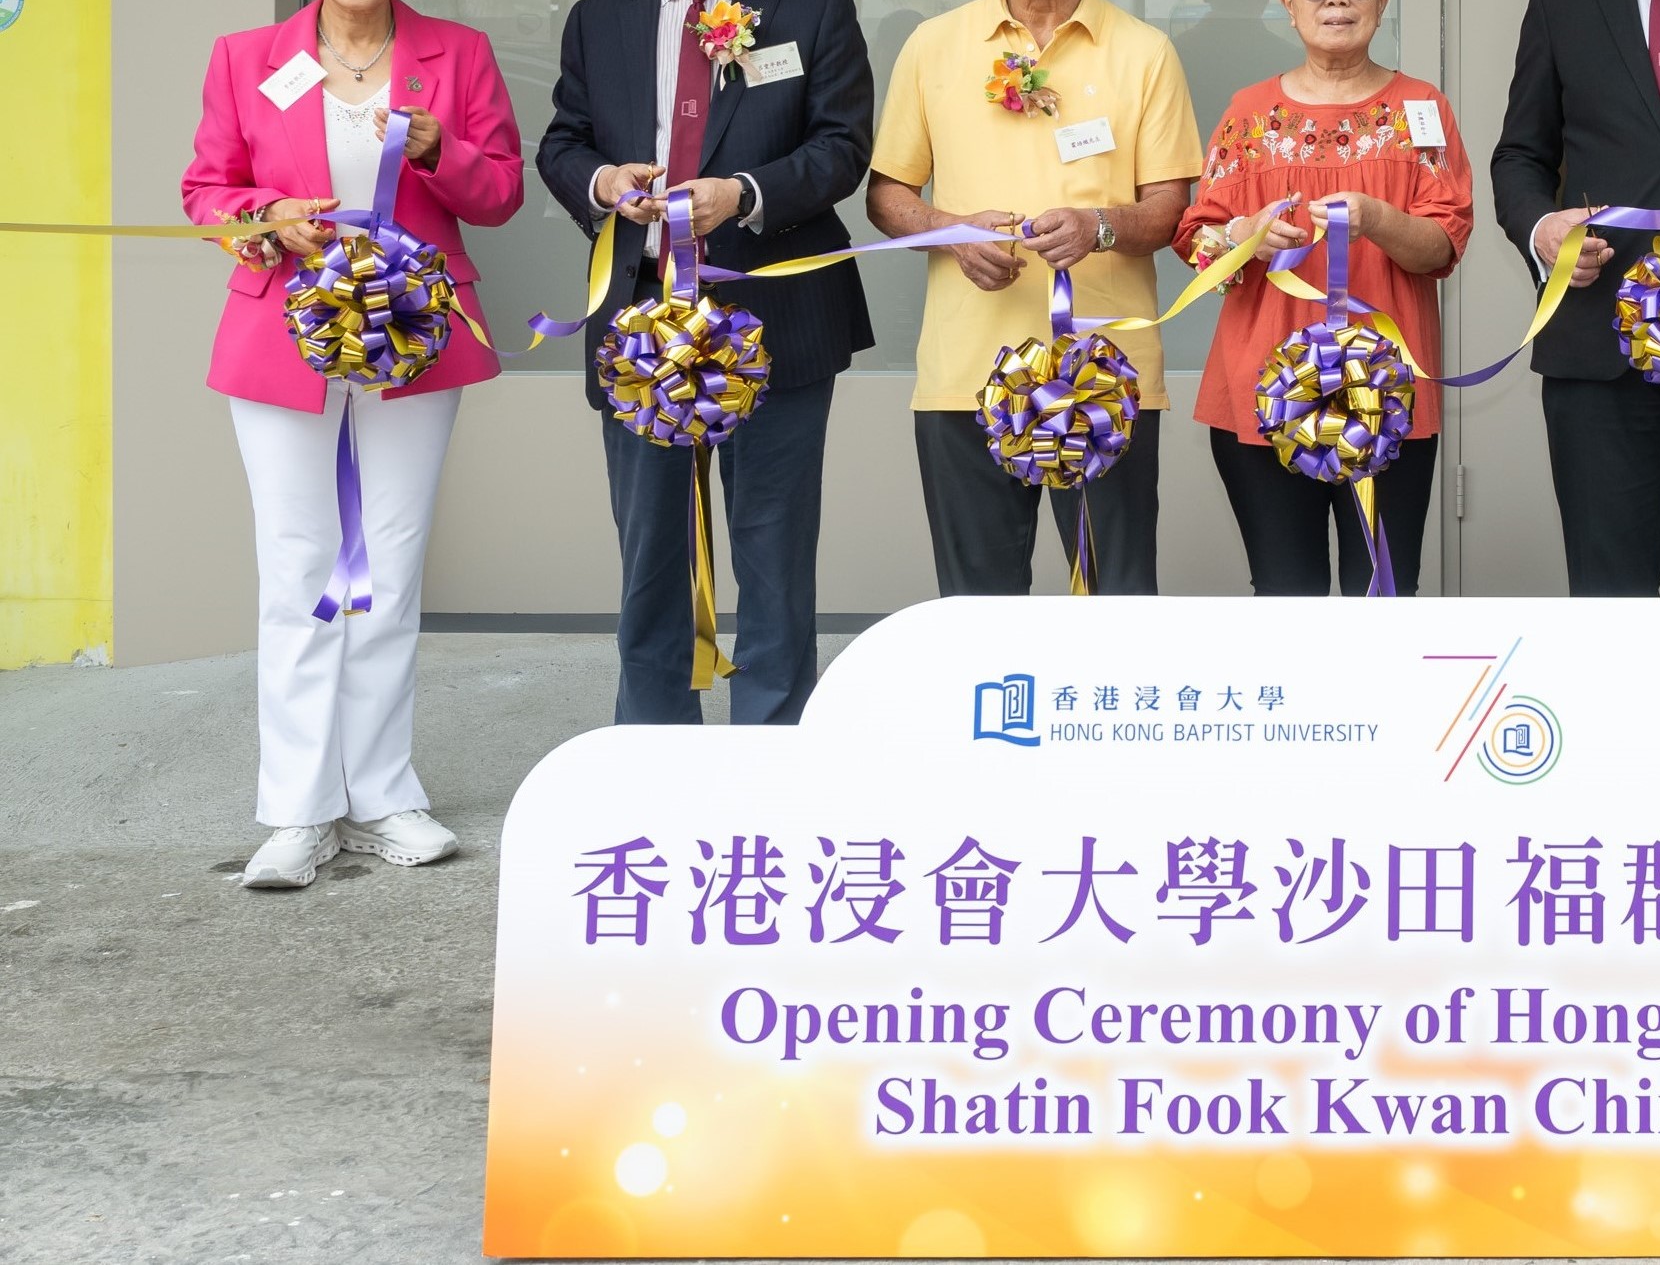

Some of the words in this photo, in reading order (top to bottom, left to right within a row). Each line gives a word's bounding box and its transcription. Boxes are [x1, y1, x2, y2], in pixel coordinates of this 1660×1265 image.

[1051, 685, 1285, 712] 香港浸會大學
[1050, 723, 1103, 742] HONG
[1112, 723, 1164, 742] KONG
[1174, 723, 1255, 742] BAPTIST
[1263, 723, 1379, 742] UNIVERSITY
[719, 986, 1011, 1061] Opening
[1033, 986, 1382, 1061] Ceremony
[1404, 986, 1475, 1044] of
[875, 1076, 1092, 1136] Shatin
[1116, 1076, 1289, 1136] Fook
[1309, 1076, 1509, 1136] Kwan
